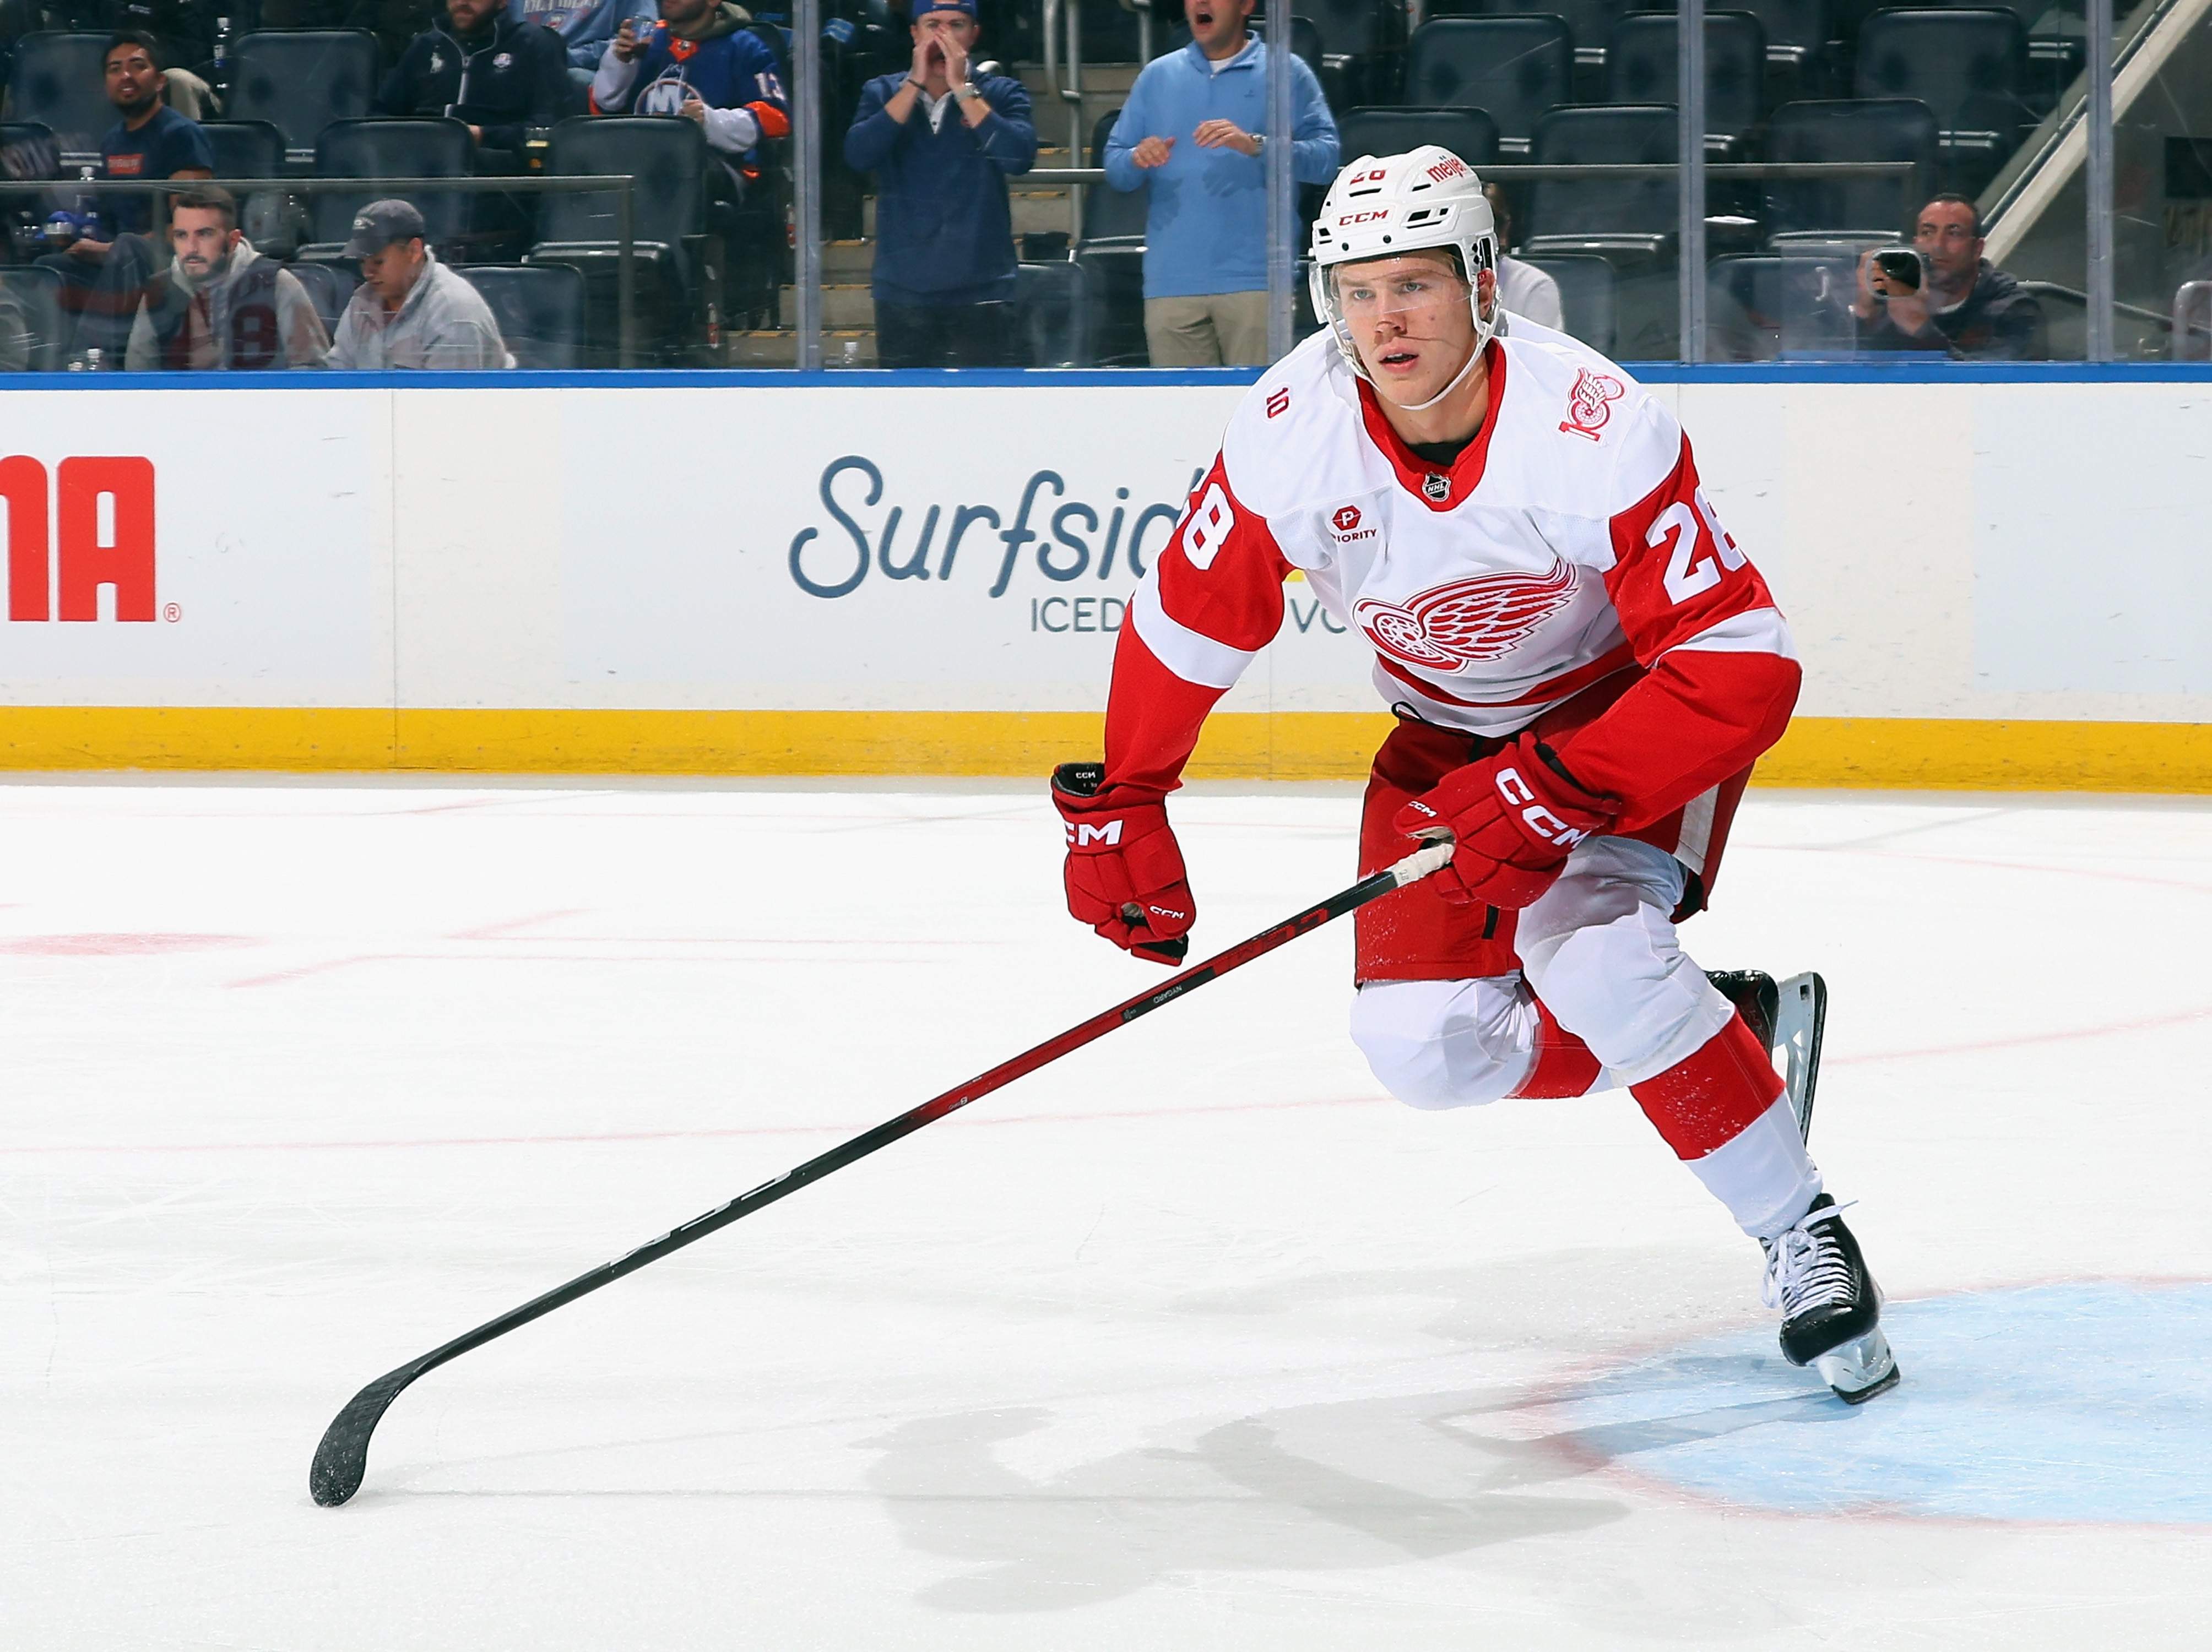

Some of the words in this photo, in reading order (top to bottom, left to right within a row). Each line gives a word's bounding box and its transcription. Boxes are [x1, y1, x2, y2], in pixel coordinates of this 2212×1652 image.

[1339, 210, 1389, 226] CCM
[1427, 483, 1445, 493] NHL
[1176, 469, 1235, 570] 8
[1331, 529, 1377, 542] IORITY
[1031, 596, 1127, 633] ICED
[1408, 801, 1437, 817] CCM
[1495, 768, 1592, 849] CCM
[1149, 905, 1185, 919] CCM
